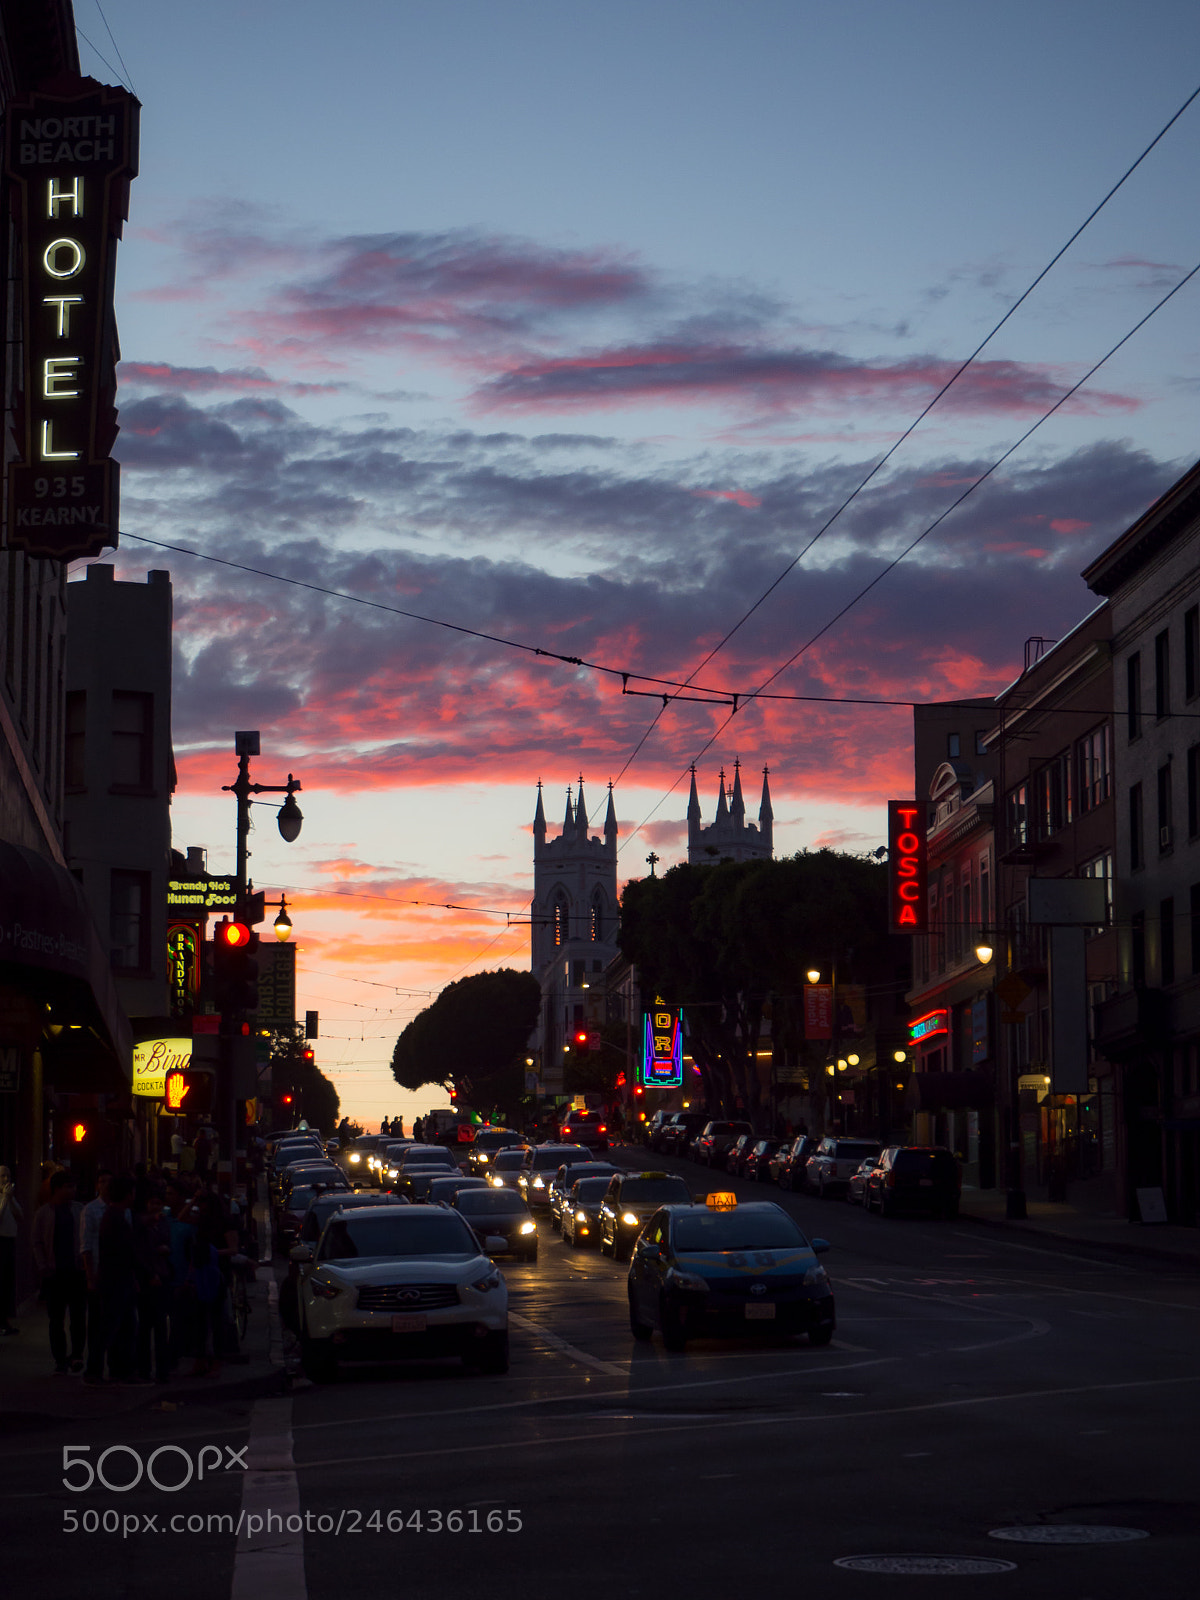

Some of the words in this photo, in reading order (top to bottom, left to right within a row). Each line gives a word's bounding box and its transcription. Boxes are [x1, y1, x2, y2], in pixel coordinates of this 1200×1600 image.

[20, 114, 116, 140] NORTH
[20, 140, 115, 165] BEACH
[40, 175, 87, 462] HOTEL
[34, 475, 86, 499] 935
[16, 505, 101, 527] KEARNY
[897, 808, 921, 927] TOSCA
[168, 880, 208, 892] Brandy
[167, 892, 204, 904] Hunan
[205, 893, 237, 906] Food
[136, 1081, 164, 1091] COCKTA
[711, 1195, 735, 1205] TAXI
